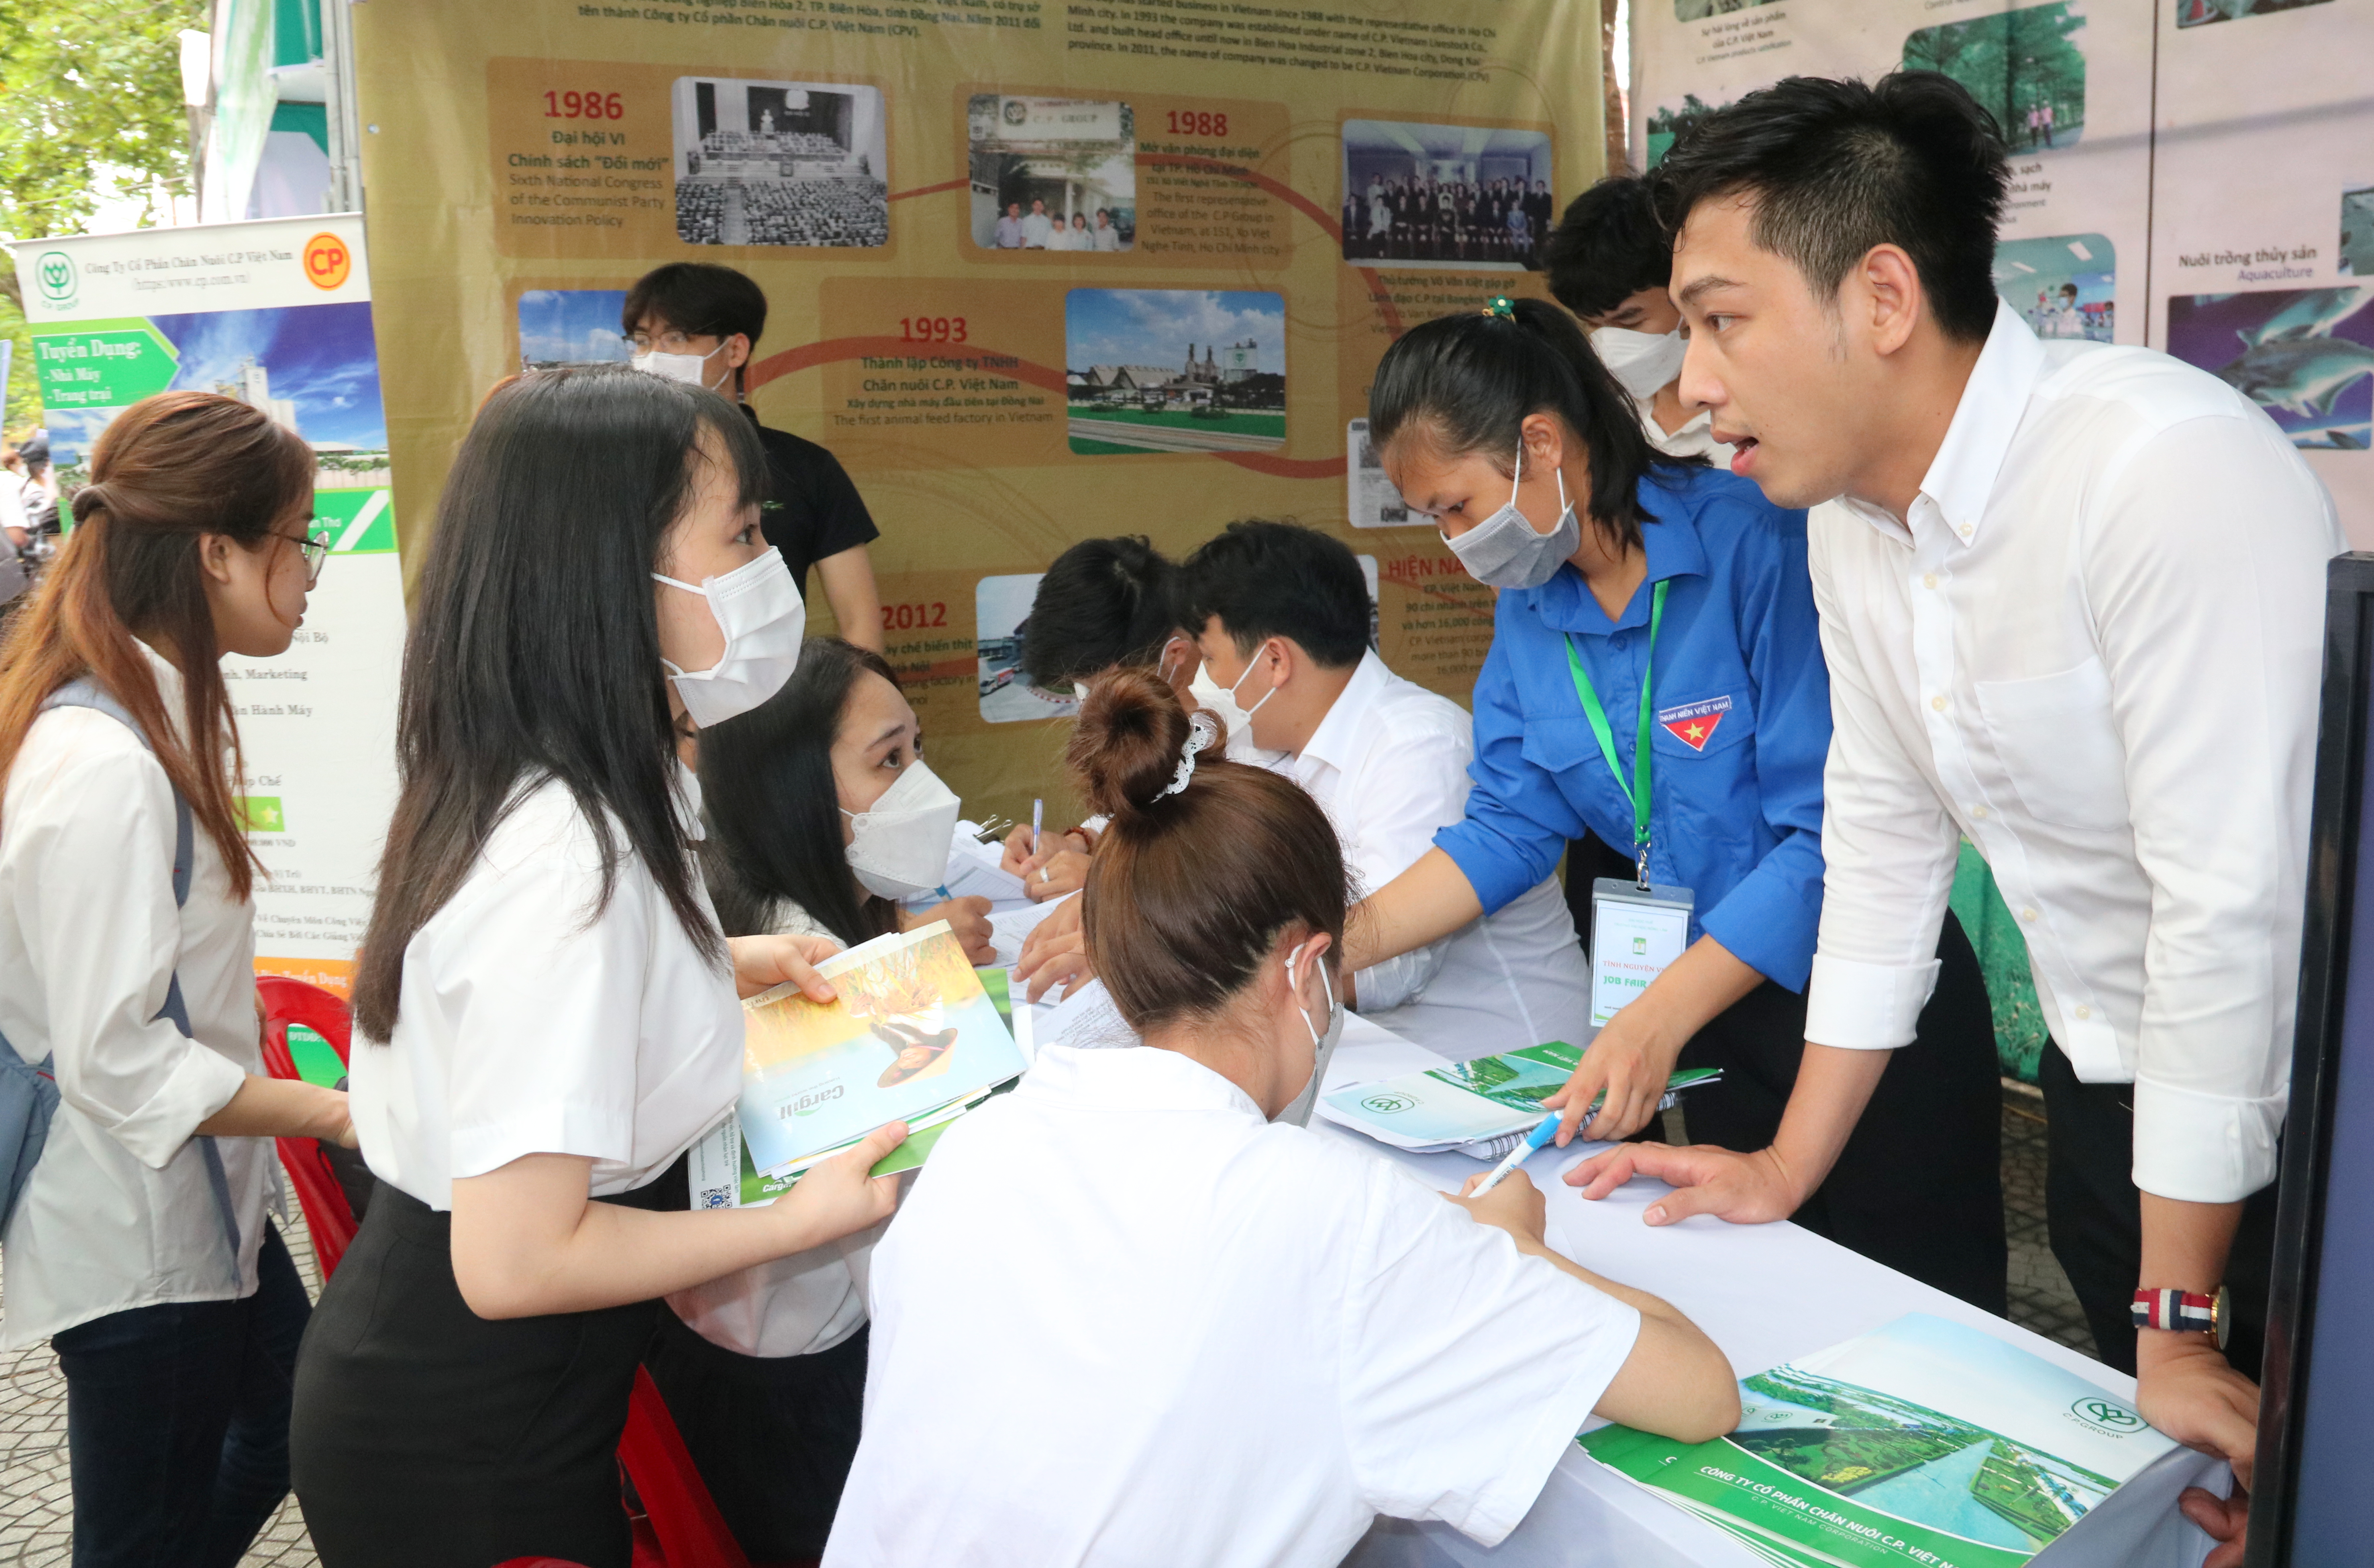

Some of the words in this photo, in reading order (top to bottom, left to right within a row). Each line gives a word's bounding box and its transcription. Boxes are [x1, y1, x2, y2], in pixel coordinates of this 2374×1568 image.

[603, 6, 640, 18] thành
[643, 8, 674, 23] Công
[678, 11, 689, 24] ty
[832, 20, 855, 34] Việt
[858, 23, 884, 34] Nam
[544, 90, 625, 120] 1986
[1167, 110, 1228, 137] 1988
[552, 130, 578, 146] Đại
[581, 131, 606, 147] hội
[609, 133, 625, 145] VI
[508, 153, 553, 167] Chính
[557, 155, 590, 168] sách
[509, 174, 542, 186] Sixth
[547, 175, 602, 188] National
[605, 176, 663, 191] Congress
[510, 193, 524, 205] of
[528, 194, 550, 206] the
[553, 194, 628, 207] Communist
[632, 196, 664, 209] Party
[512, 214, 582, 225] Innovation
[585, 214, 623, 228] Policy
[310, 247, 343, 276] CP
[2179, 253, 2210, 267] Nuôi
[2214, 250, 2251, 267] trồng
[2255, 245, 2288, 264] thủy
[2292, 243, 2317, 260] sản
[2237, 266, 2313, 283] Aquaculture
[900, 317, 967, 343] 1993
[38, 337, 89, 363] Tuyển
[90, 338, 143, 360] Dụng:
[861, 356, 903, 369] Thành
[930, 356, 963, 371] Công
[863, 379, 896, 391] Chăn
[900, 378, 928, 391] nuôi
[959, 378, 985, 392] Việt
[989, 378, 1018, 390] Nam
[834, 414, 855, 426] The
[859, 413, 881, 425] first
[884, 413, 922, 424] animal
[926, 412, 950, 424] feed
[954, 412, 992, 425] factory
[1008, 411, 1053, 422] Vietnam
[1389, 555, 1432, 581] HIỆN
[881, 602, 948, 630] 2012
[245, 668, 308, 681] Marketing
[251, 704, 284, 715] Hành
[288, 704, 314, 718] Máy
[1659, 713, 1677, 722] THANH
[1694, 704, 1711, 715] VIỆT
[1712, 701, 1729, 711] NAM
[1603, 960, 1621, 969] TÌNH
[1623, 962, 1655, 973] NGUYỆN
[1603, 975, 1621, 985] JOB
[1624, 978, 1647, 988] FAIR
[780, 1085, 844, 1120] Cargill
[1700, 1466, 1736, 1482] CÔNG
[1735, 1476, 1755, 1486] TY
[1752, 1482, 1776, 1495] CỔ
[1770, 1490, 1810, 1511] PHẦN
[1808, 1505, 1848, 1525] CHĂN
[1845, 1521, 1882, 1539] NUÔI
[1880, 1535, 1906, 1550] C.P.
[1908, 1546, 1941, 1566] VIỆT
[1771, 1504, 1793, 1516] VIET
[1795, 1513, 1817, 1526] NAM
[1819, 1523, 1889, 1555] CORPORATION
